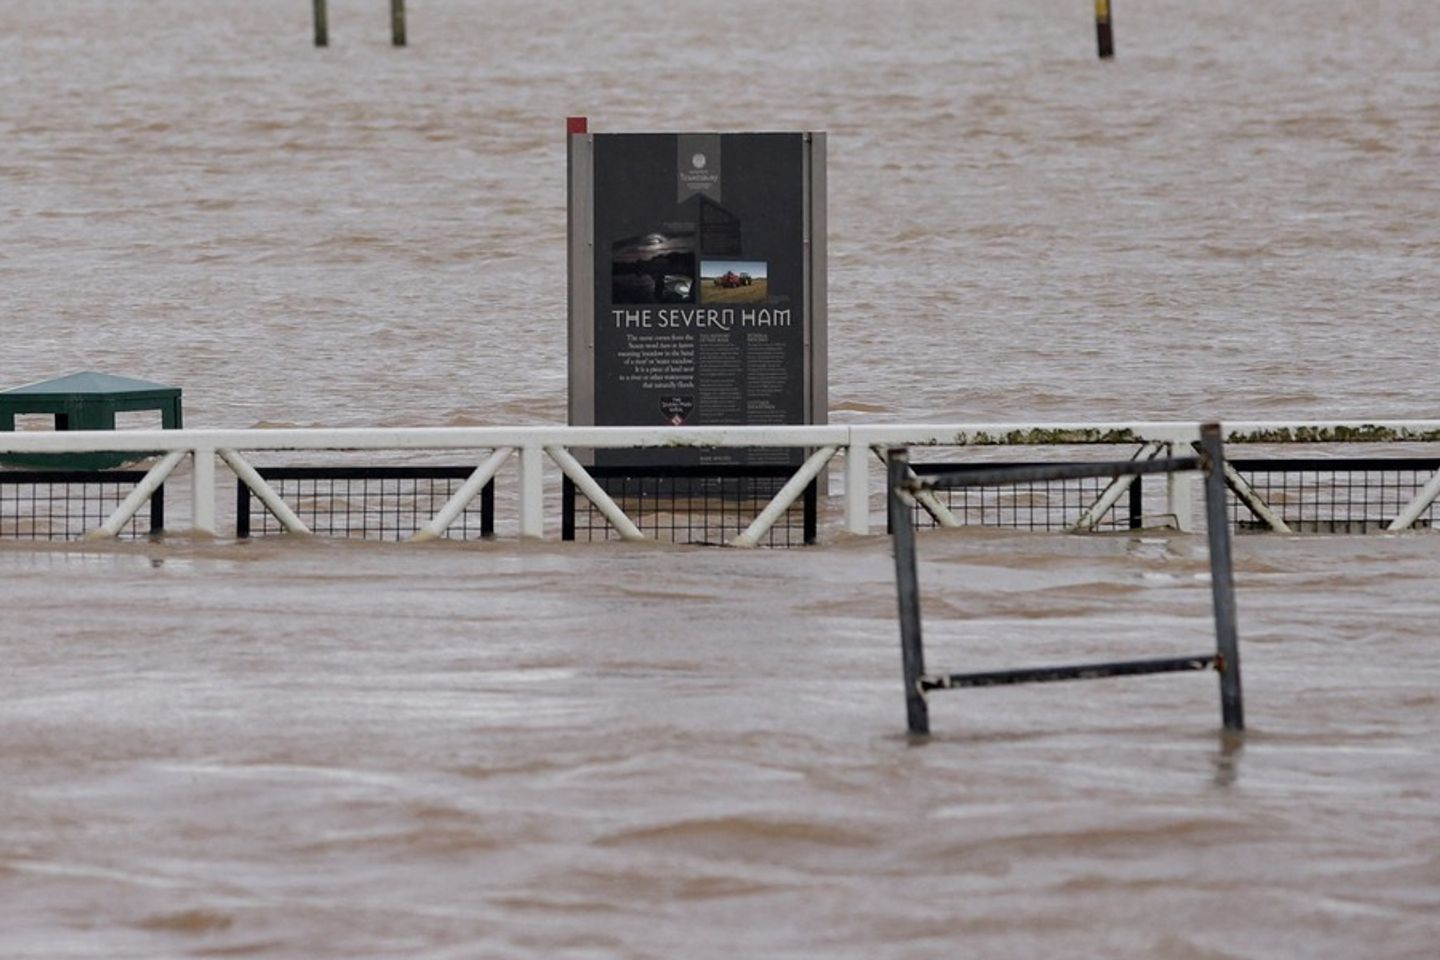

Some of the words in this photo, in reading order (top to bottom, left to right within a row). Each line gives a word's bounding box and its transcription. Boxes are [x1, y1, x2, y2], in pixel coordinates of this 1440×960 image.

[611, 309, 652, 328] THE
[657, 308, 734, 331] SEVERN
[741, 308, 791, 327] HAM
